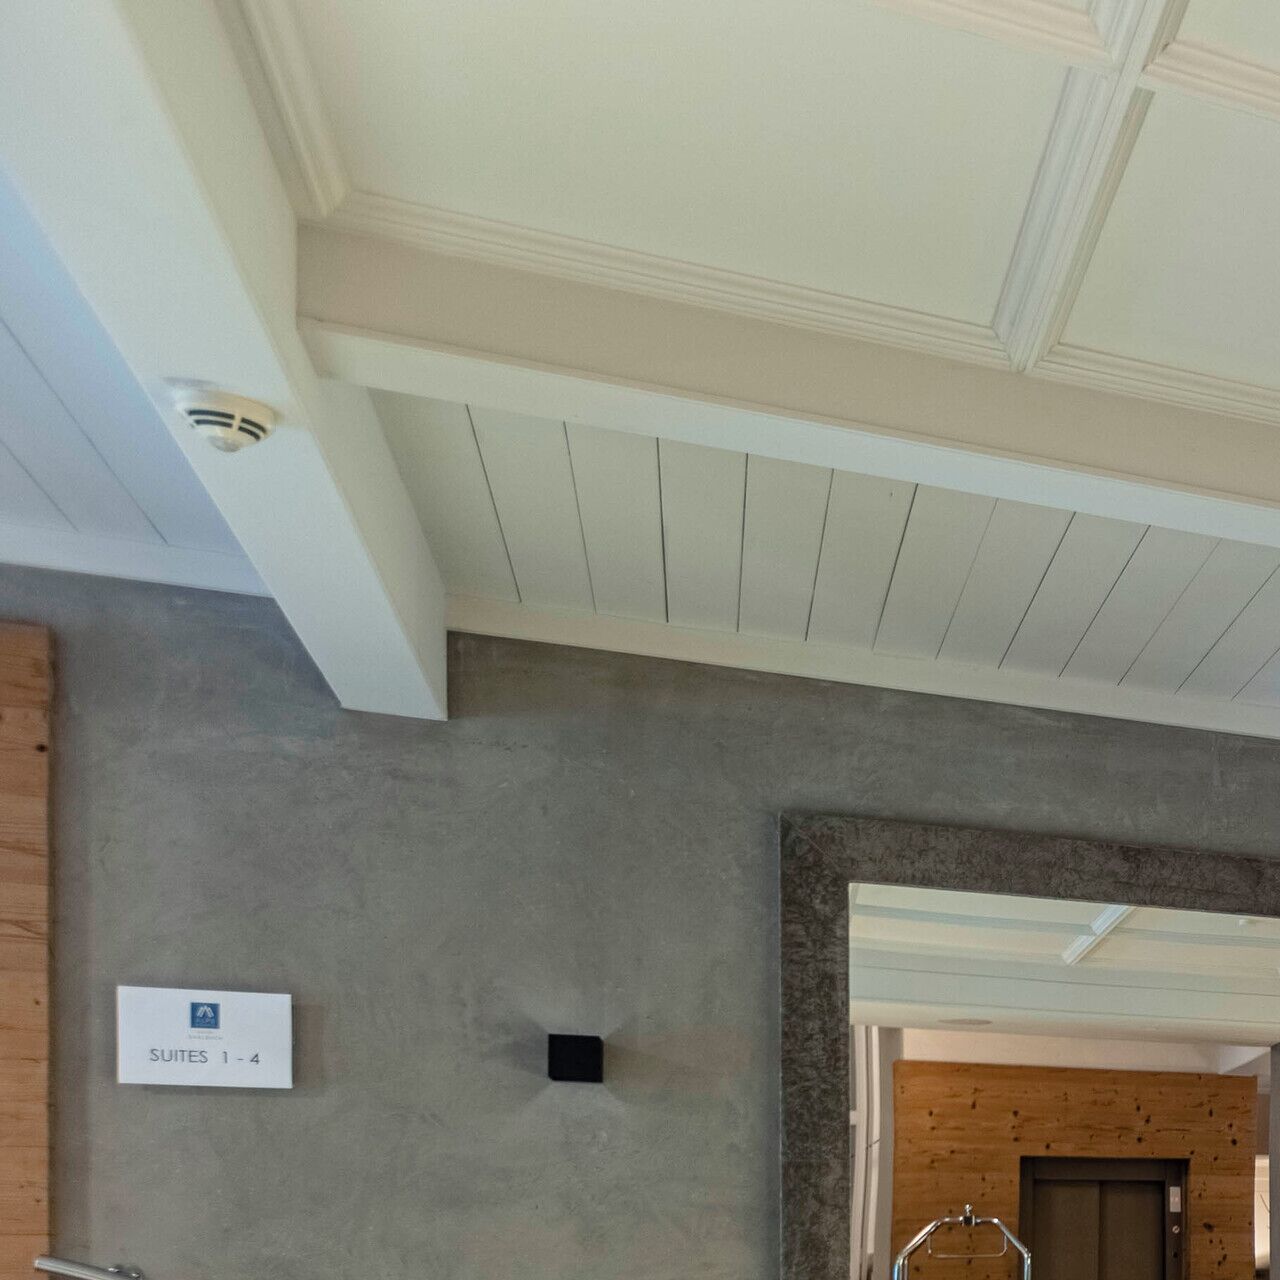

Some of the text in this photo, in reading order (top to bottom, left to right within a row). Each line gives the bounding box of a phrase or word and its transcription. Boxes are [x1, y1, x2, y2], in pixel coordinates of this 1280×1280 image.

[150, 1048, 209, 1064] SUITES
[222, 1050, 228, 1064] 1
[249, 1052, 260, 1065] 4
